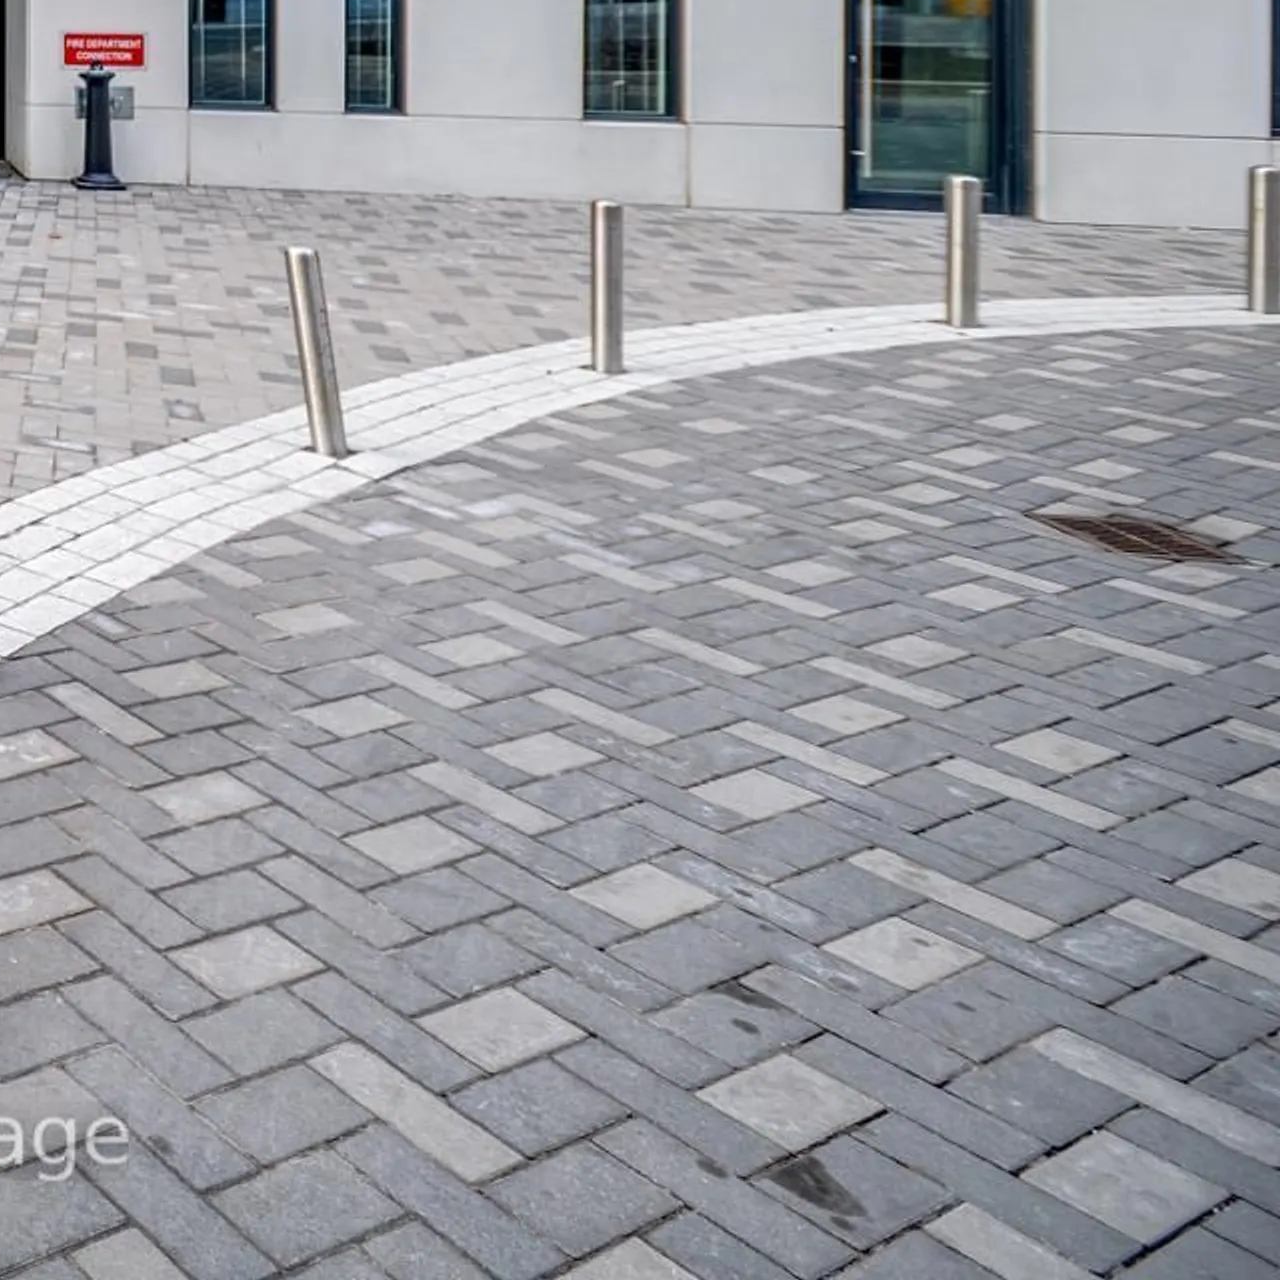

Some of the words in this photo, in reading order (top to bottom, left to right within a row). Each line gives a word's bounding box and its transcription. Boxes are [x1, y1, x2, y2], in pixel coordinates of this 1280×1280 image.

[66, 38, 84, 49] FIRE
[86, 38, 141, 49] DEPARTMENT
[76, 51, 133, 61] CONNECTION
